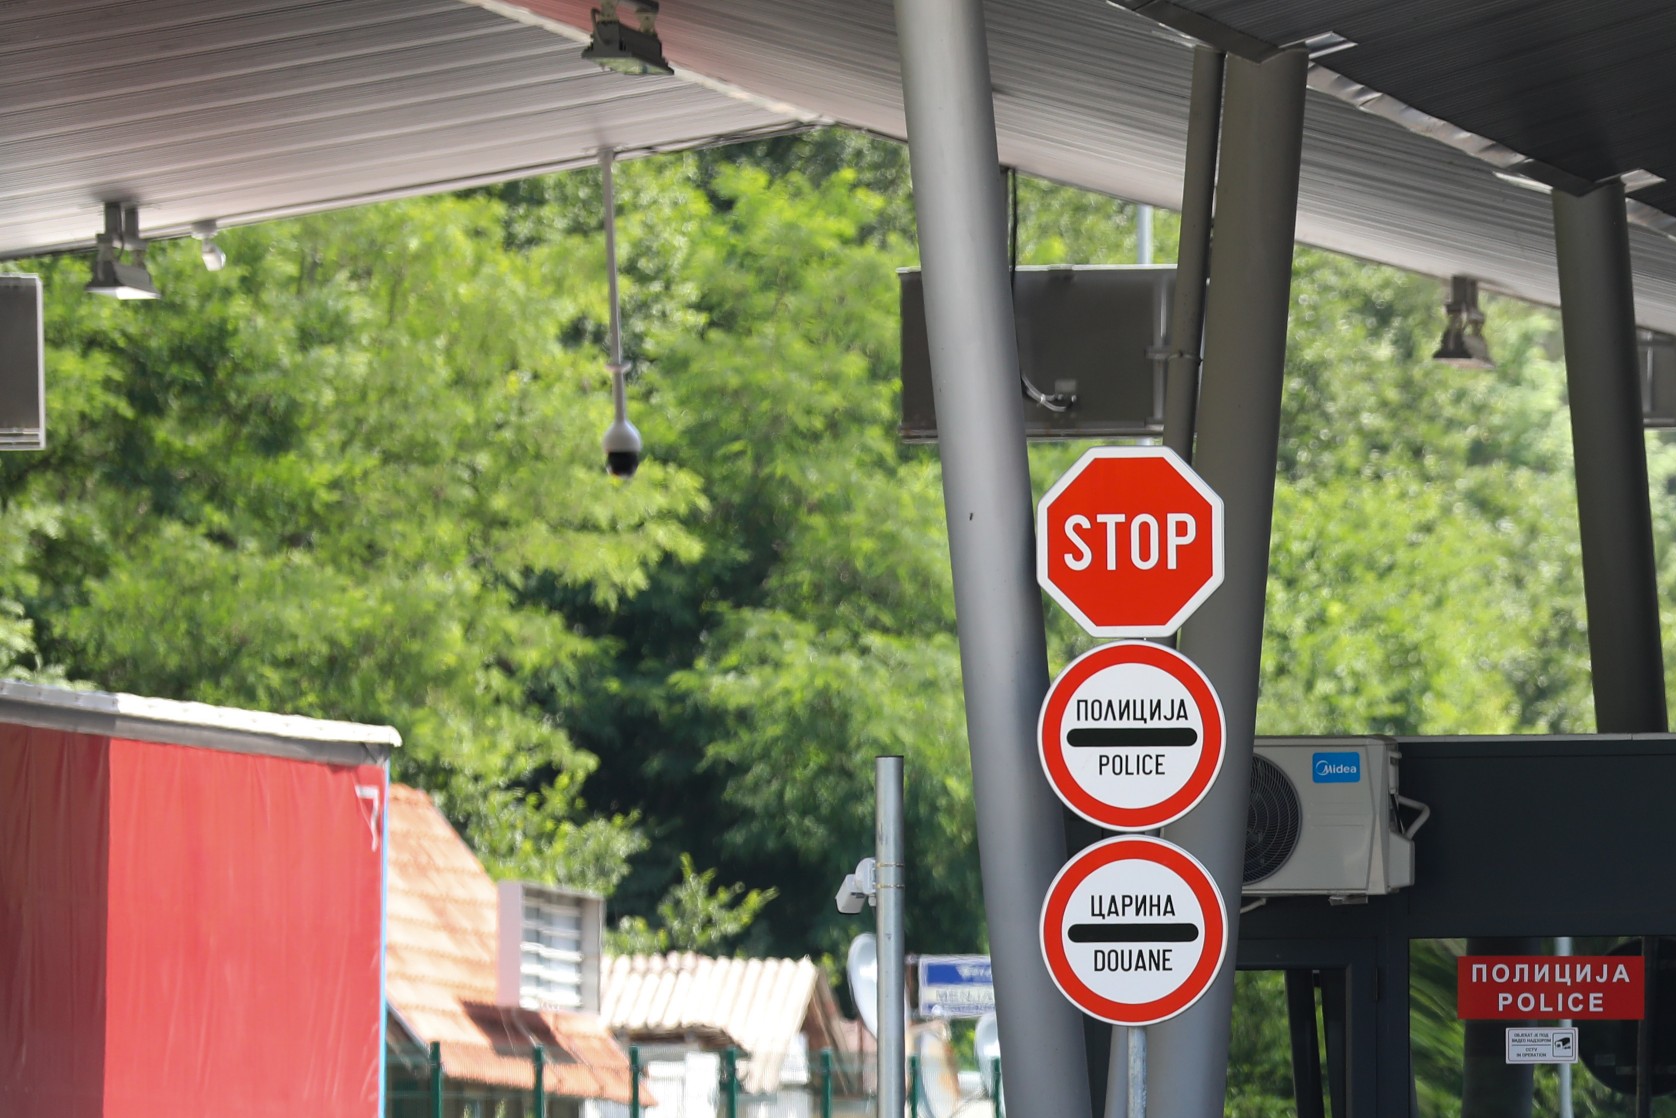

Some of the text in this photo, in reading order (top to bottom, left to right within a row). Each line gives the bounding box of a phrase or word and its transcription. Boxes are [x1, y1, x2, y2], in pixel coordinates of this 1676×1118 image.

[1063, 512, 1197, 572] STOP
[1076, 698, 1189, 724] ПОЛИЦИЈА
[1098, 754, 1166, 776] POLICE
[1317, 761, 1357, 775] Midea
[1090, 894, 1177, 920] ЦАРИНА
[1093, 948, 1173, 972] DOUANE
[1471, 963, 1631, 986] ПОЛИЦИЈА
[1498, 992, 1604, 1012] POLICE
